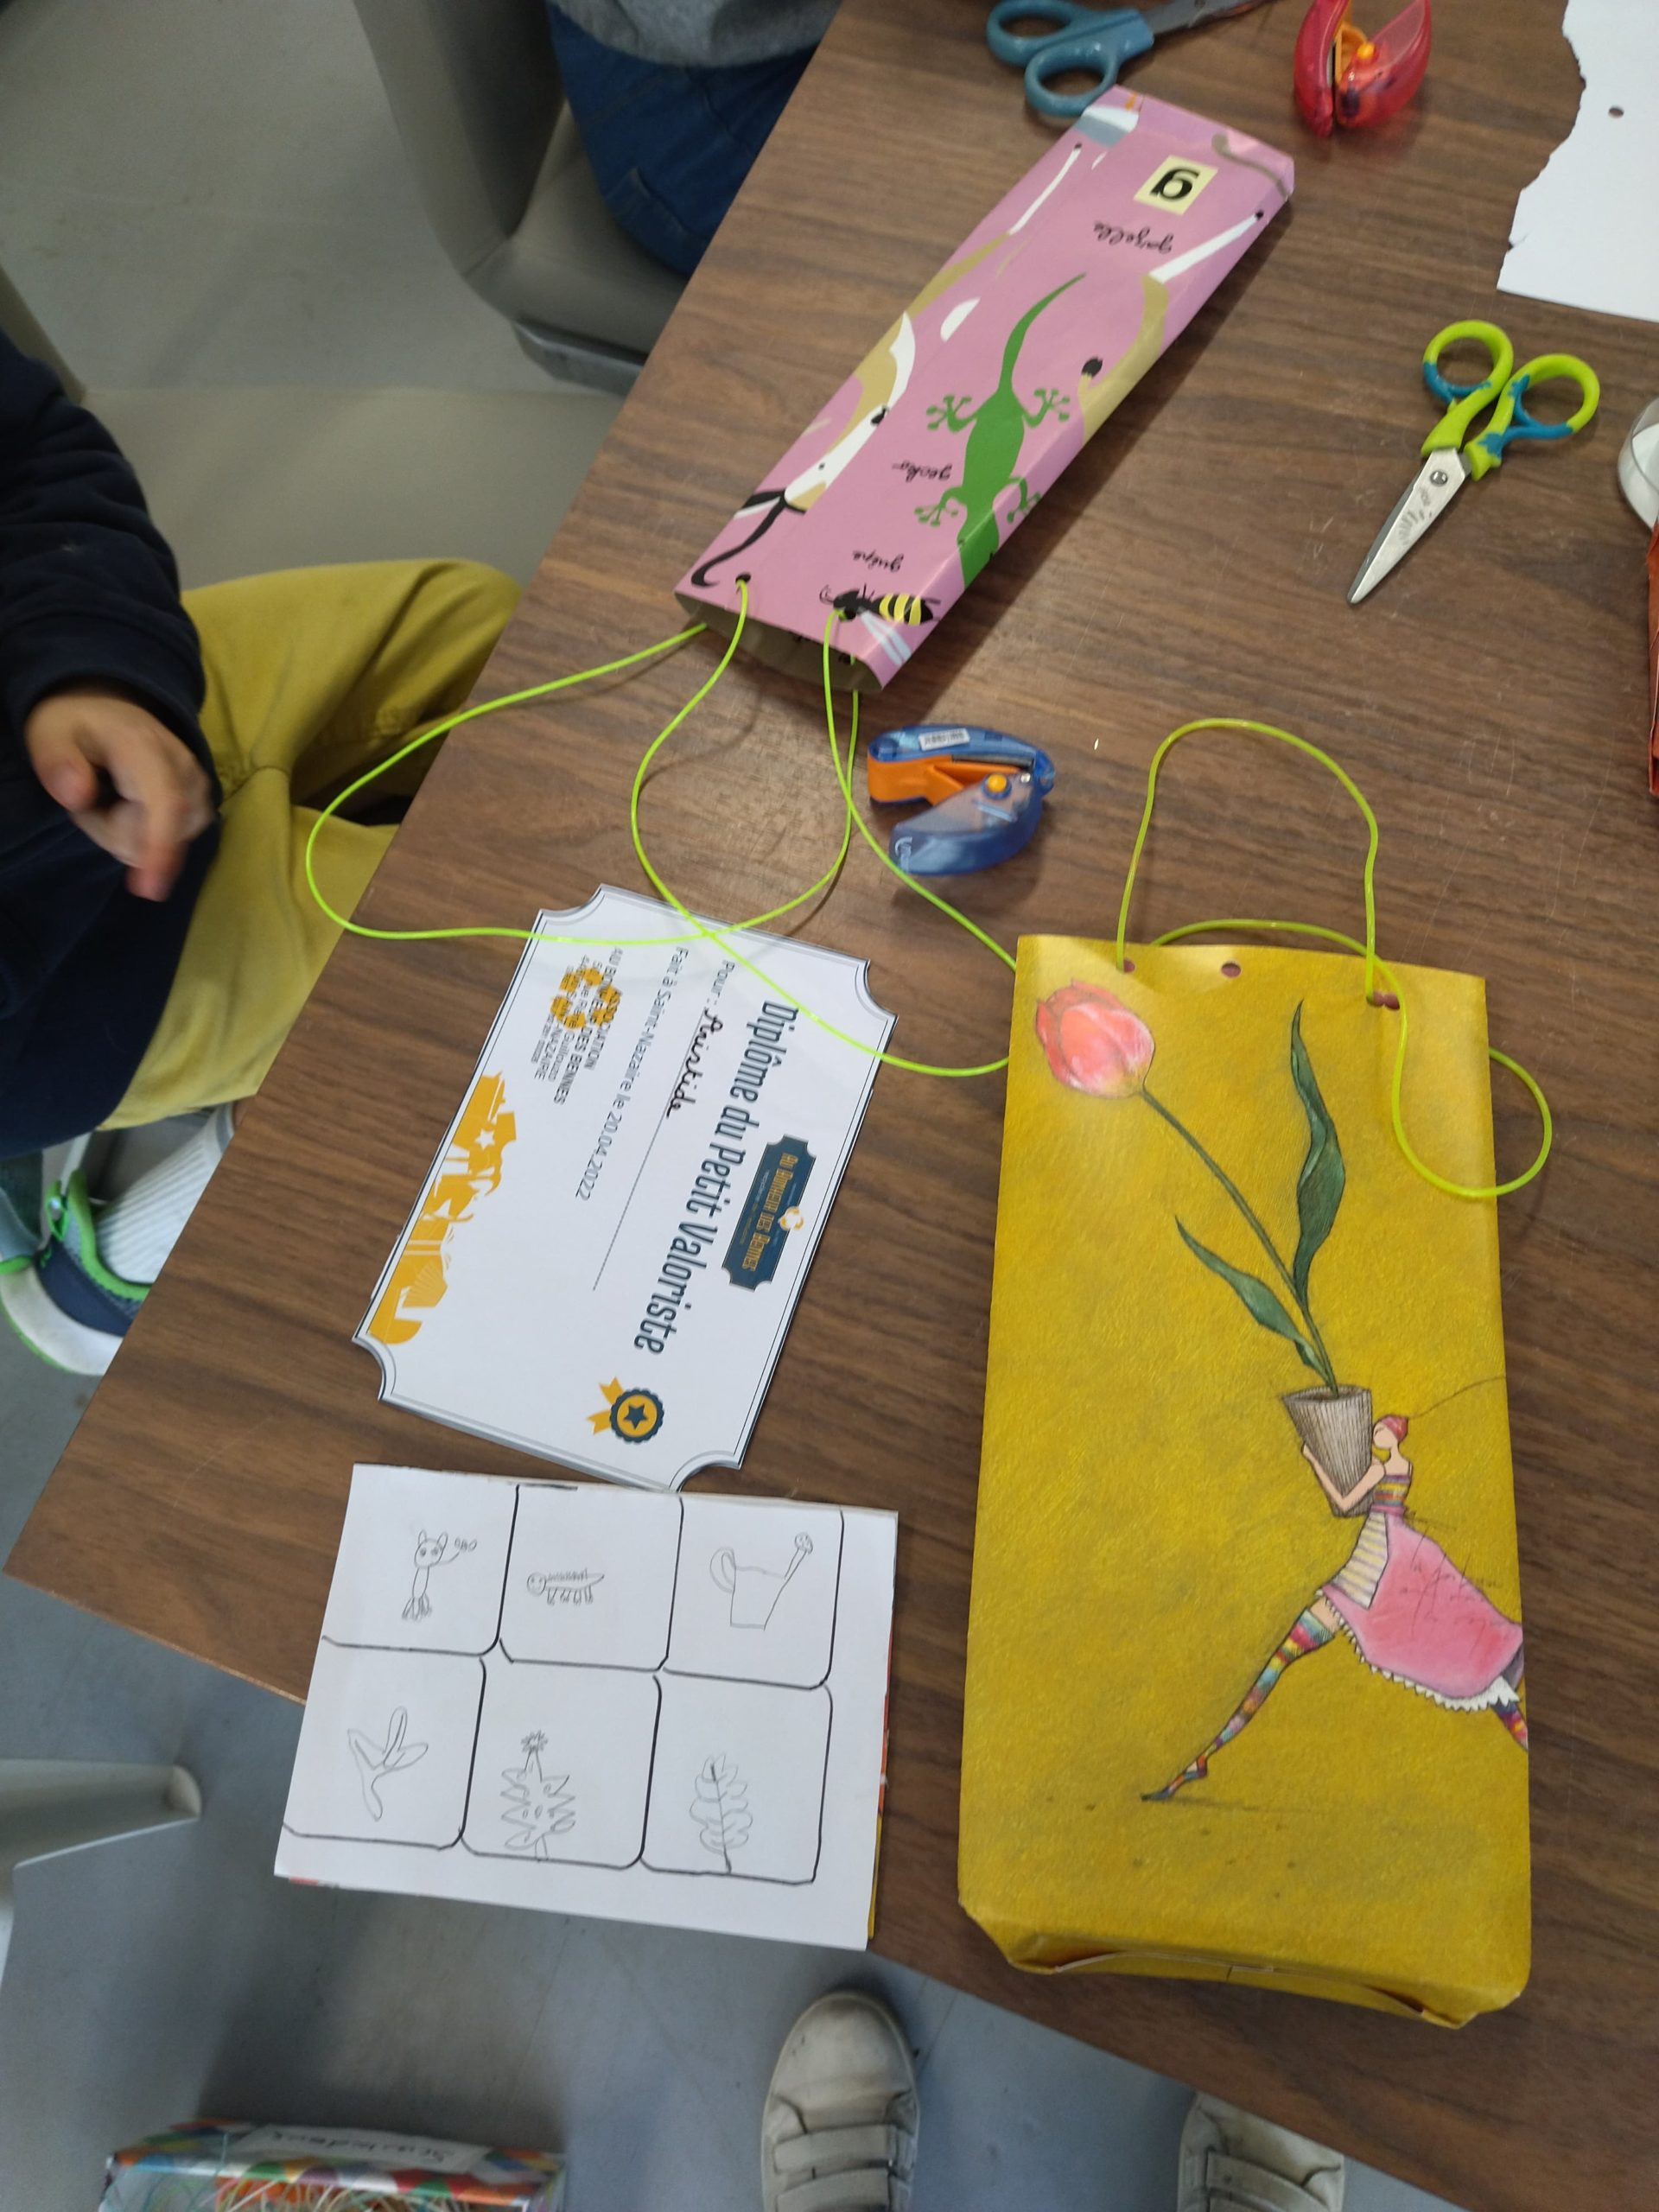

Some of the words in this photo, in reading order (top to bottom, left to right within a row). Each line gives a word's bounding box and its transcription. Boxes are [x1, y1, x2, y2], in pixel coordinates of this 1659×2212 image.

[1149, 167, 1200, 201] g
[1093, 220, 1174, 254] gazelle
[892, 460, 952, 483] gecko
[671, 946, 690, 974] Fait
[710, 959, 735, 997] Pour
[662, 974, 677, 987] à
[575, 1026, 593, 1053] DES
[620, 987, 672, 1091] Saint-Nazaire
[729, 1000, 799, 1103] Diplôme
[554, 1052, 582, 1106] BENNES
[666, 1007, 724, 1119] Aristide
[612, 1092, 632, 1110] le
[715, 1104, 760, 1140] du
[575, 1110, 623, 1201] 20.04.2022
[686, 1142, 747, 1218] Petit
[633, 1221, 717, 1355] Valoriste
